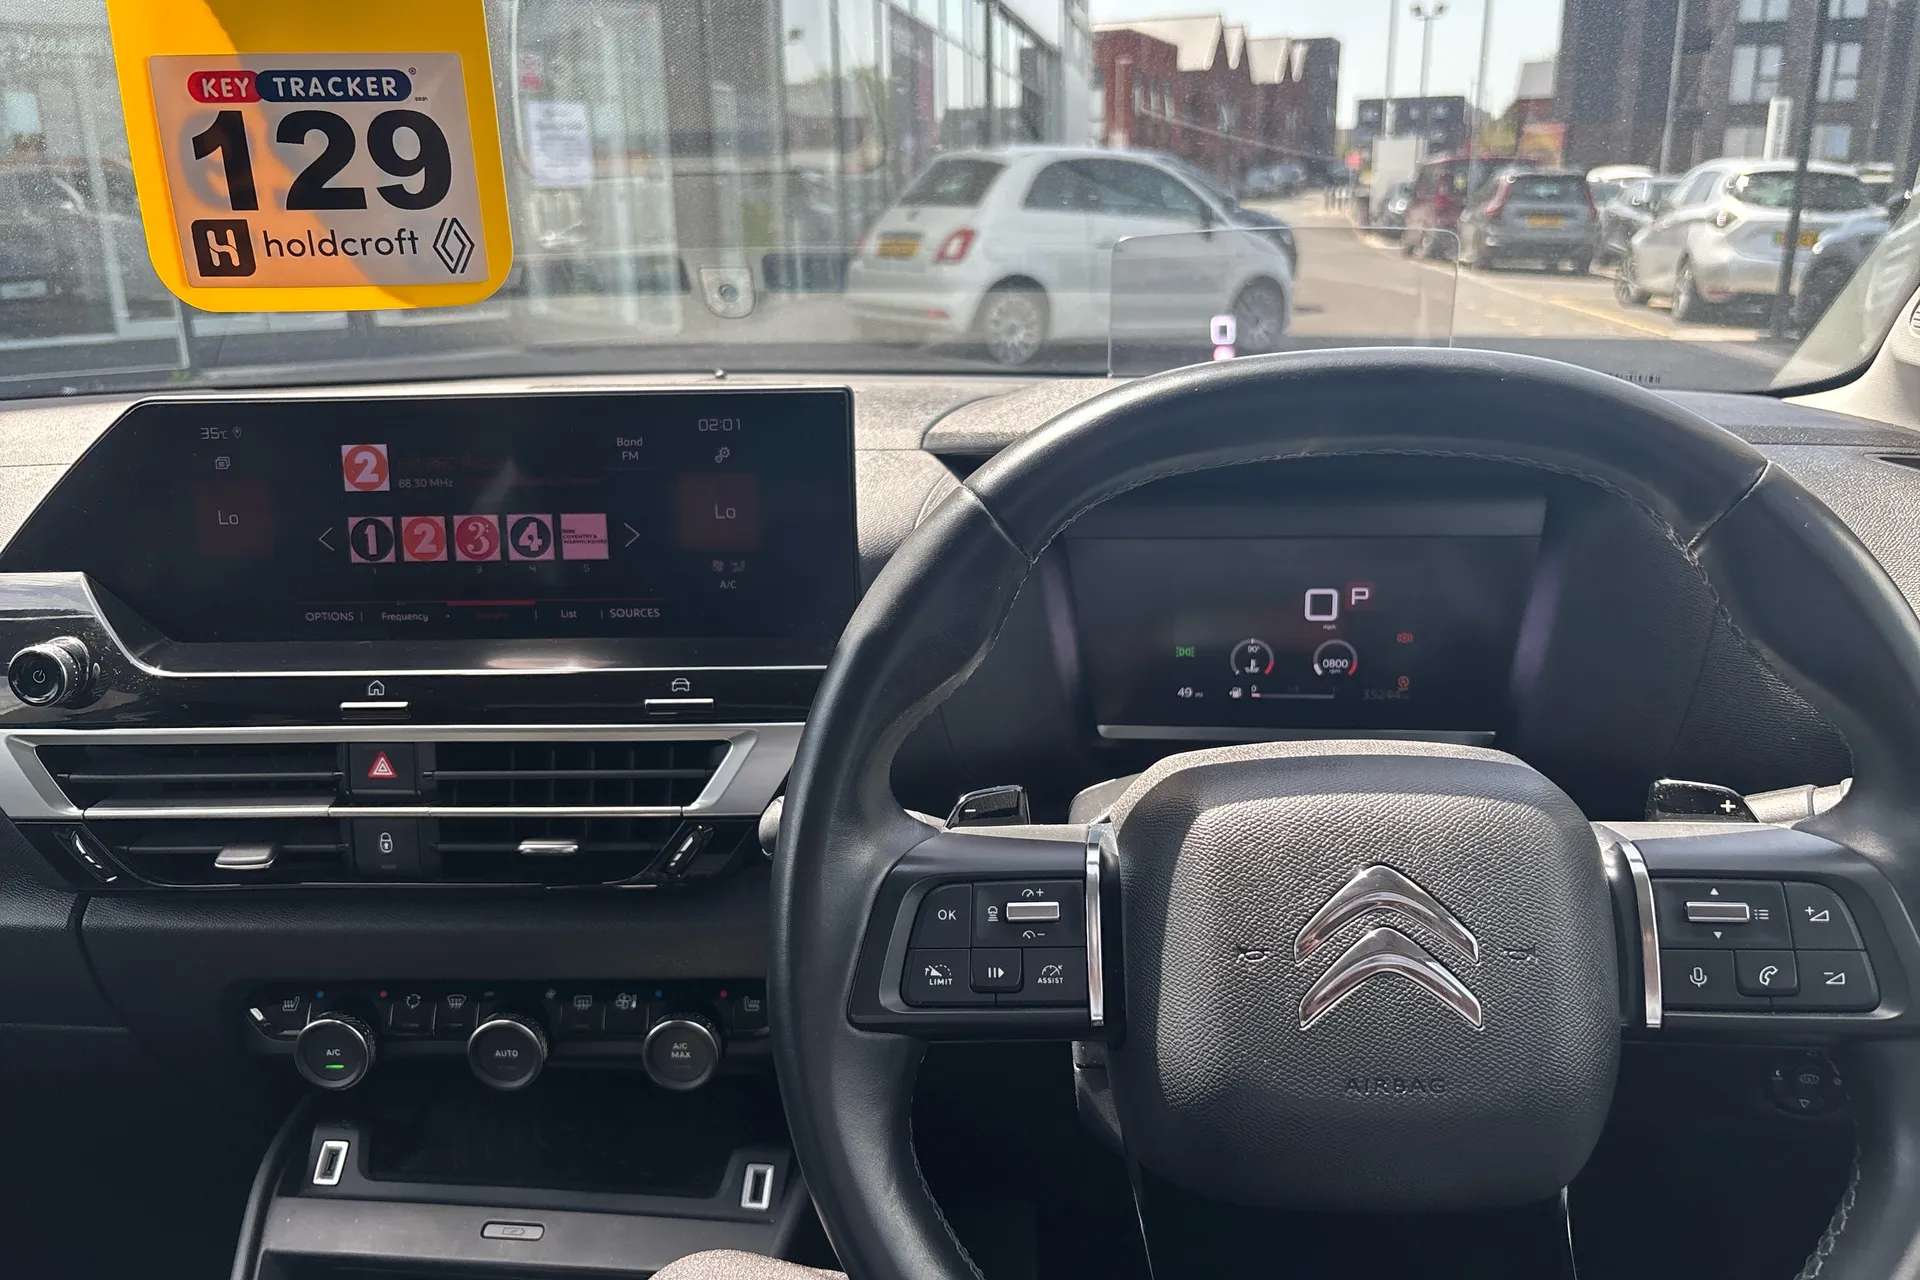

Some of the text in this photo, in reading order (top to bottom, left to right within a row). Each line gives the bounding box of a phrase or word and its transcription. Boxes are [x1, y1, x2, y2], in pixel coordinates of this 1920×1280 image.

[201, 76, 398, 99] KEY TRACKER
[192, 109, 452, 212] 129
[263, 227, 419, 259] holdcroft
[697, 417, 741, 432] 02:01
[615, 437, 643, 448] Band
[621, 452, 640, 462] FM
[430, 478, 455, 489] MHz
[217, 509, 240, 526] Lo
[714, 503, 737, 520] Lo
[719, 580, 737, 590] A/C
[1351, 587, 1369, 605] P
[1304, 587, 1339, 622] 0
[305, 610, 354, 623] OPTIONS
[381, 610, 430, 624] Frequency
[560, 609, 578, 620] List
[609, 606, 661, 620] SOURCES
[1322, 658, 1348, 669] 0800
[1176, 687, 1193, 698] 49
[937, 909, 957, 921] OK
[929, 978, 953, 986] LIMIT
[673, 1042, 688, 1051] A/C
[326, 1048, 342, 1058] A/C
[494, 1049, 519, 1059] AUTO
[671, 1051, 692, 1060] MAX
[1344, 1078, 1448, 1095] AIRBAG
